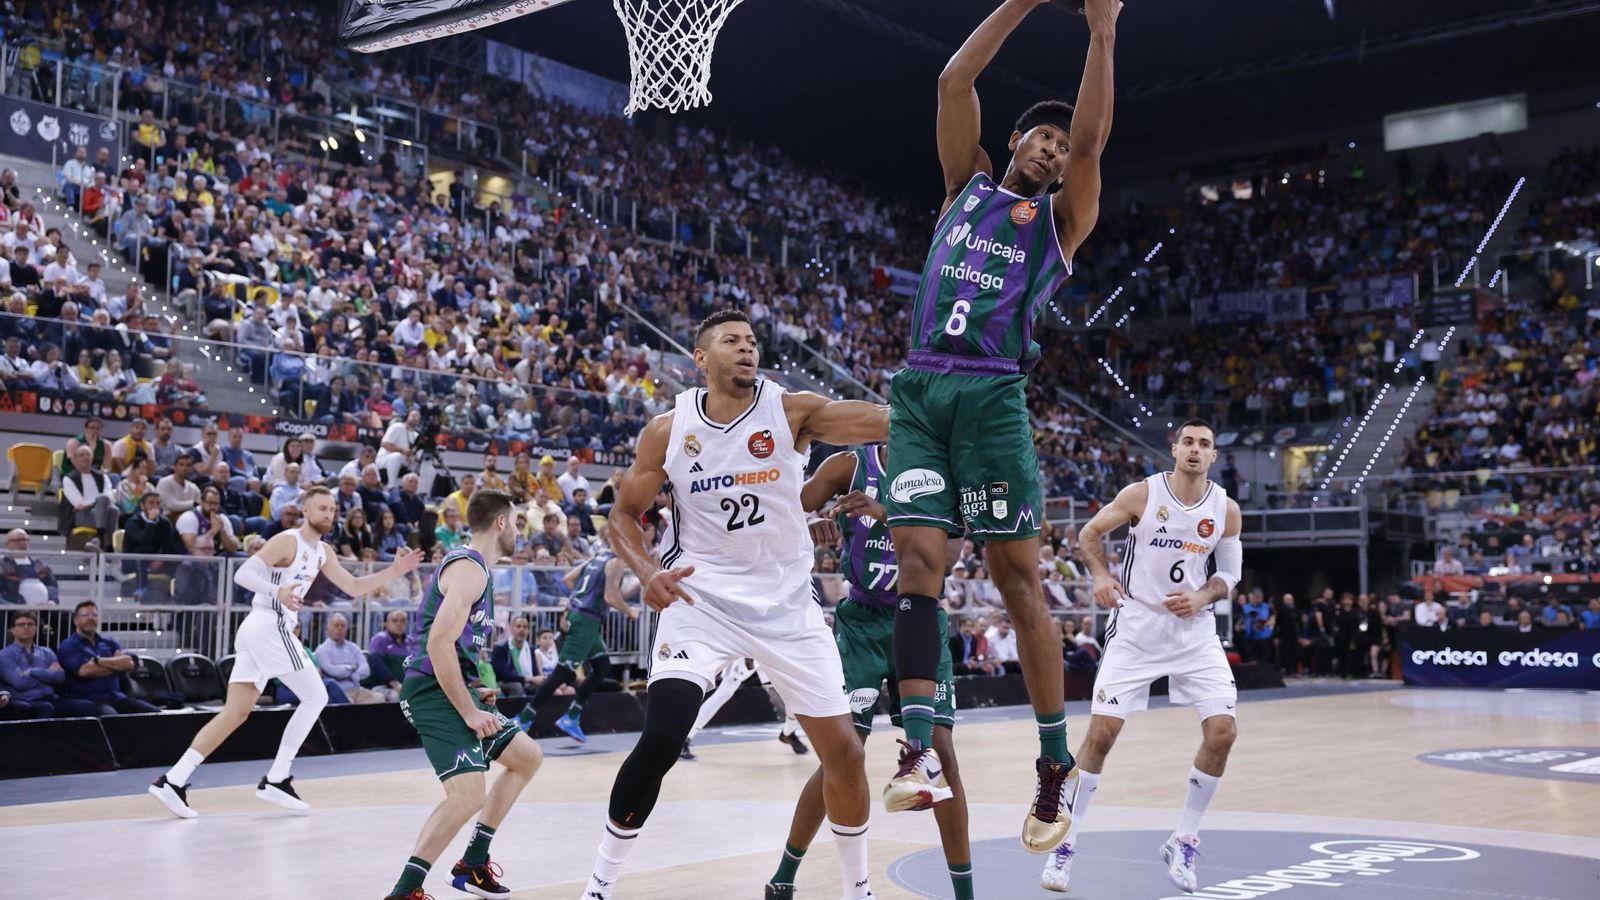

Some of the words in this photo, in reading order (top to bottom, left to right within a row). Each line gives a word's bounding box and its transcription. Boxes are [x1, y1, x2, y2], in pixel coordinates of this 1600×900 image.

[965, 232, 1026, 264] Unicaja
[940, 261, 1004, 290] málaga
[945, 299, 971, 336] 6
[690, 468, 781, 494] AUTOHERO
[720, 493, 765, 531] 22
[868, 562, 899, 591] 77
[1169, 560, 1185, 584] 6
[1411, 646, 1488, 666] endesa
[1498, 648, 1579, 667] endesa
